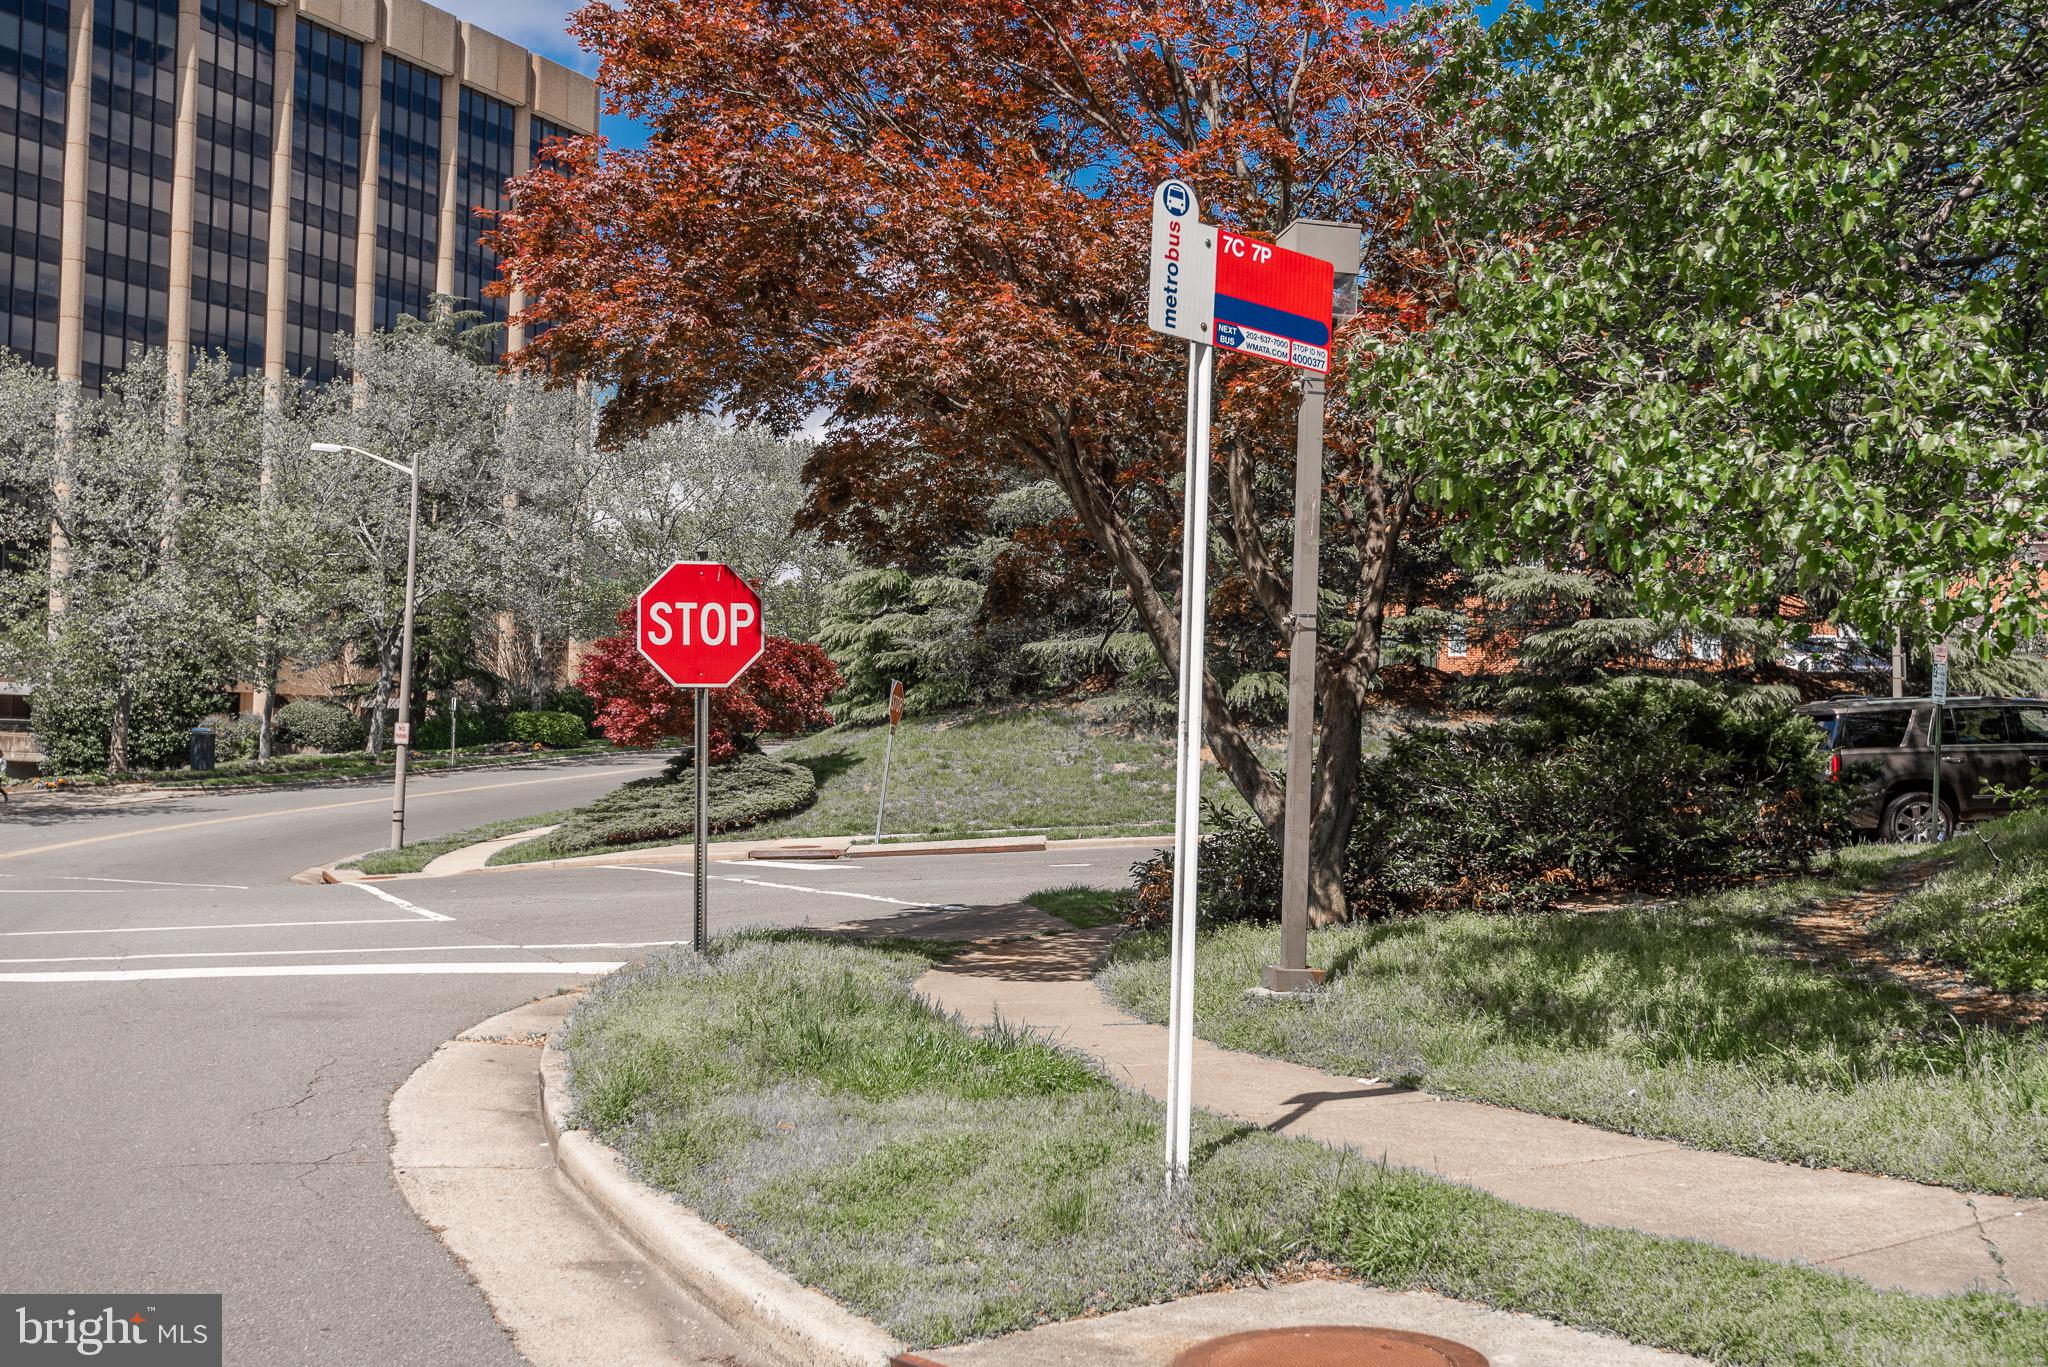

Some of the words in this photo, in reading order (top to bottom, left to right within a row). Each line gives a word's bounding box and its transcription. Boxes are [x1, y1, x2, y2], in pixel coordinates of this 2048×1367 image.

[1222, 235, 1245, 258] 7C
[1251, 243, 1272, 264] 7P
[1163, 220, 1181, 329] metrobus
[1218, 324, 1237, 335] NEXT
[1219, 335, 1235, 346] BUS
[1245, 331, 1289, 349] 202-637-7000
[1245, 342, 1288, 360] WMATA.COM
[1292, 343, 1309, 355] STOP
[1309, 348, 1316, 356] ID
[1292, 353, 1326, 369] 4000377
[647, 601, 755, 647] STOP
